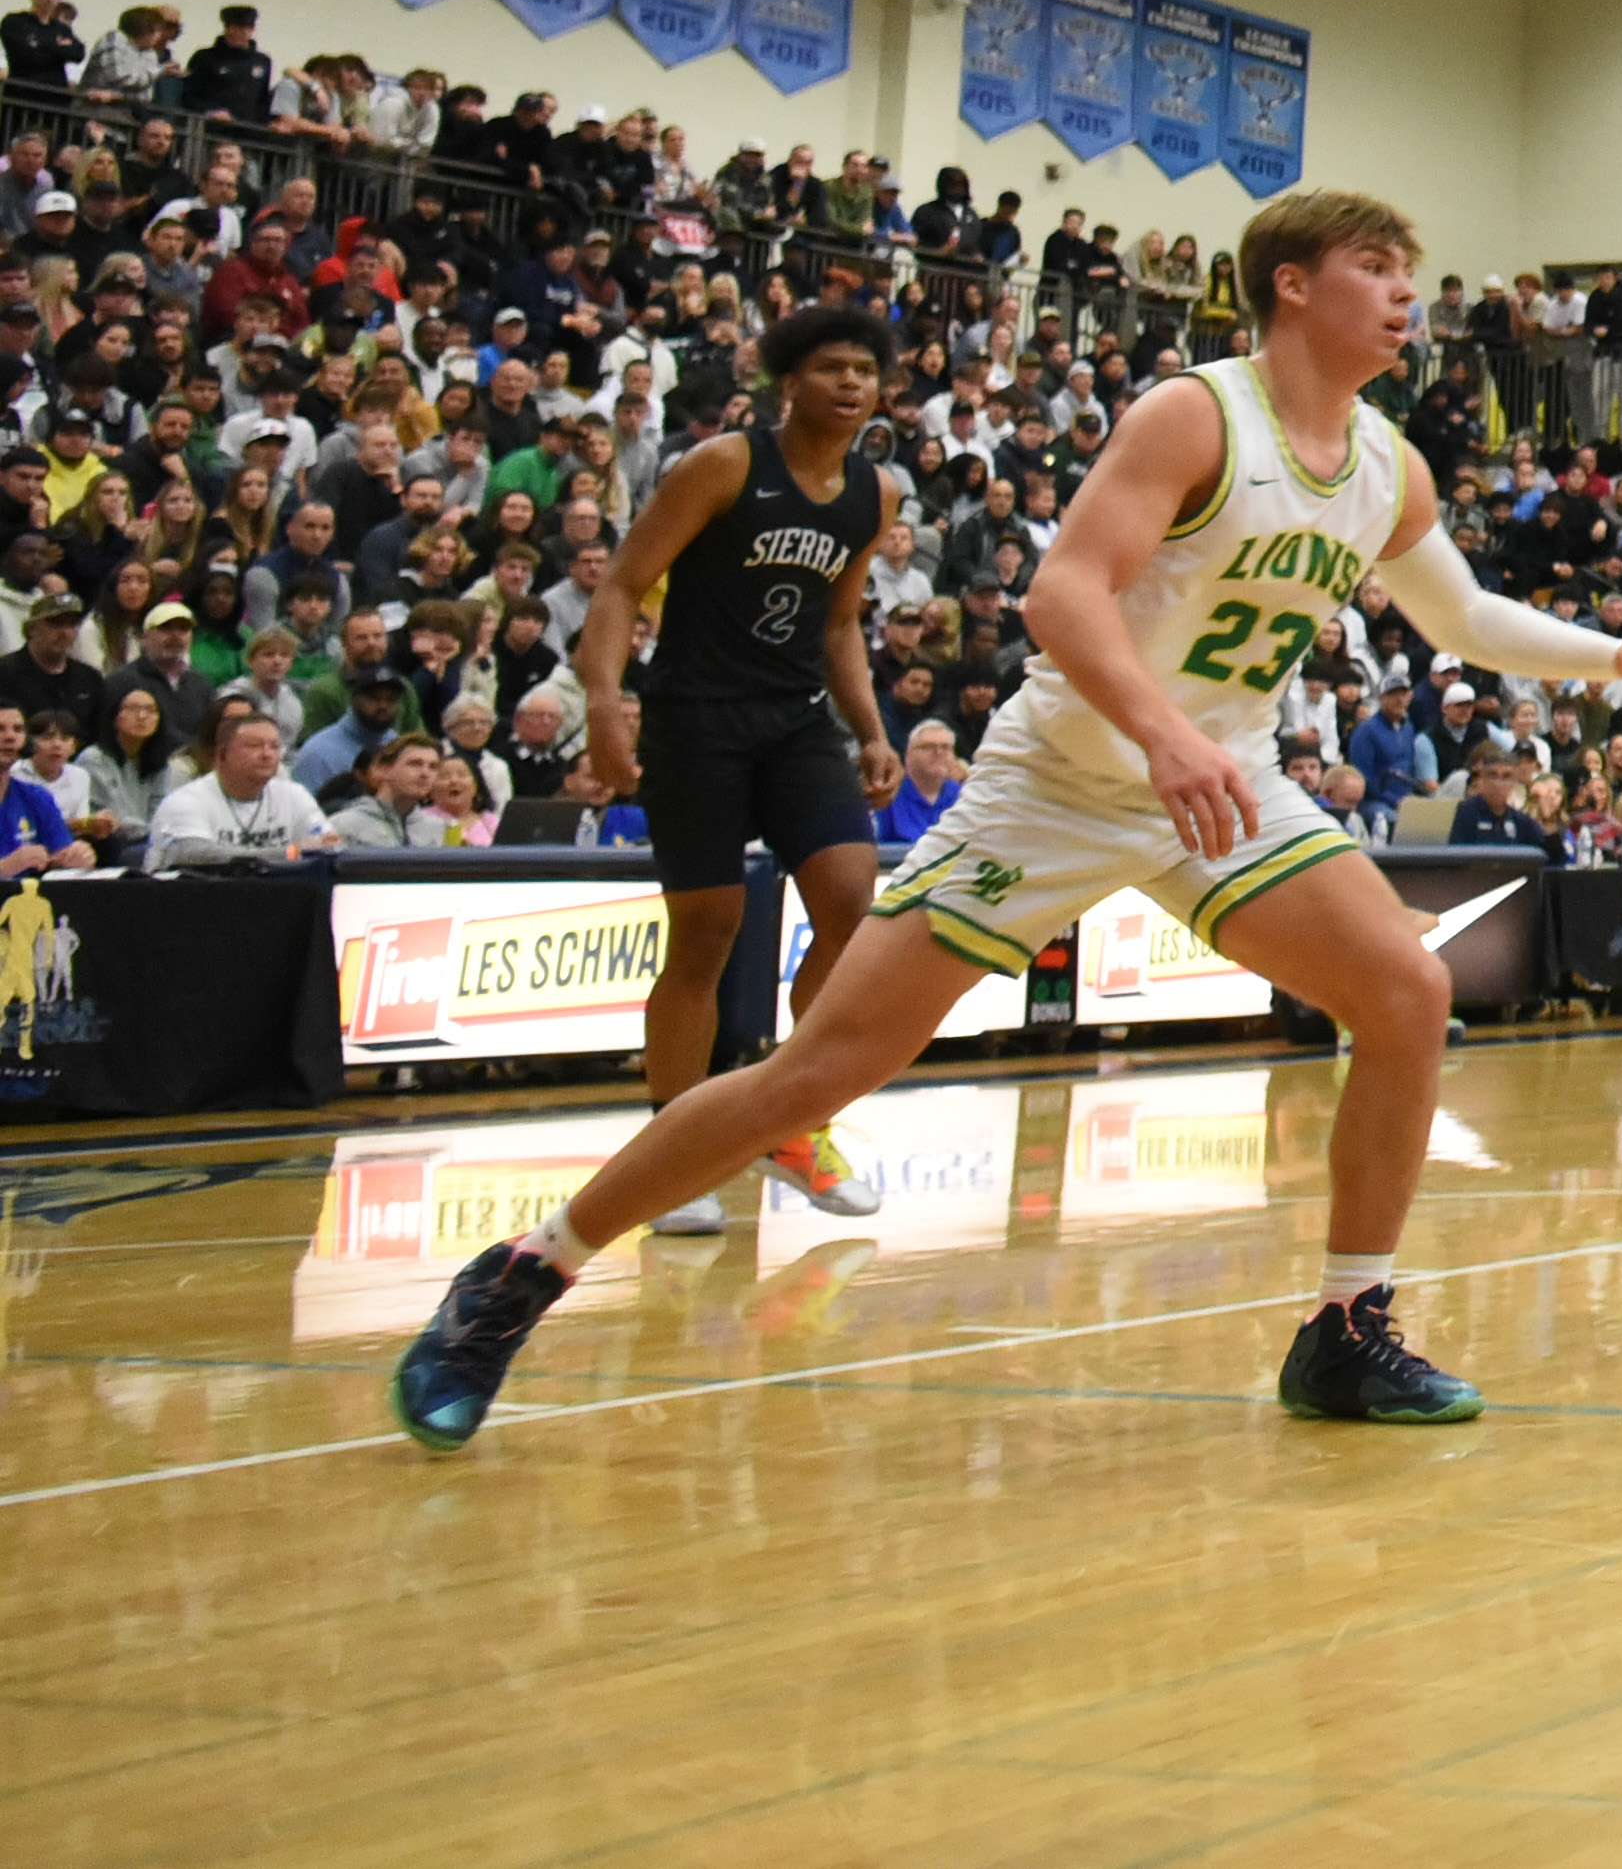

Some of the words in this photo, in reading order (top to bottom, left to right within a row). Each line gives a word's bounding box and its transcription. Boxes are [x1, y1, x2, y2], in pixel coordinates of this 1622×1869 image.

[743, 526, 852, 583] SIERRA
[1216, 528, 1364, 607] LIONS
[751, 583, 802, 644] 2
[1178, 598, 1319, 696] 23
[456, 939, 519, 997] LES
[530, 919, 662, 990] SCHWA
[1149, 926, 1182, 966] LES
